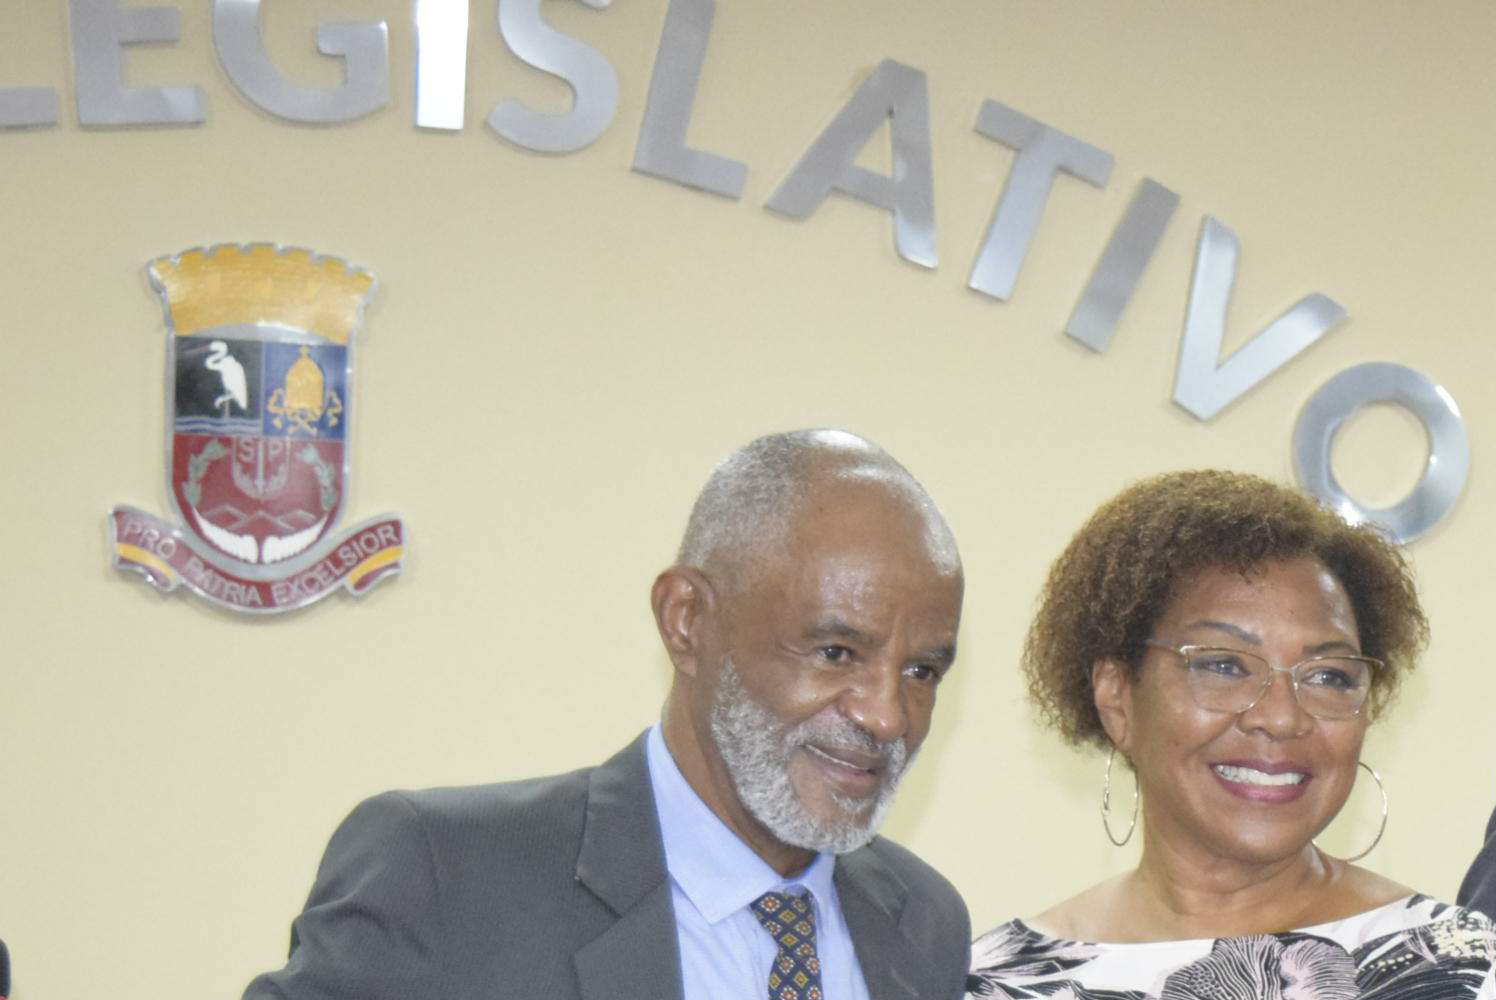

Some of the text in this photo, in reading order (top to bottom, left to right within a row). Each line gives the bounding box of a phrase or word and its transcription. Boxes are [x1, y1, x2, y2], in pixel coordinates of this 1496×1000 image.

[123, 519, 399, 606] PRO PATRIA EXCELSIOR
